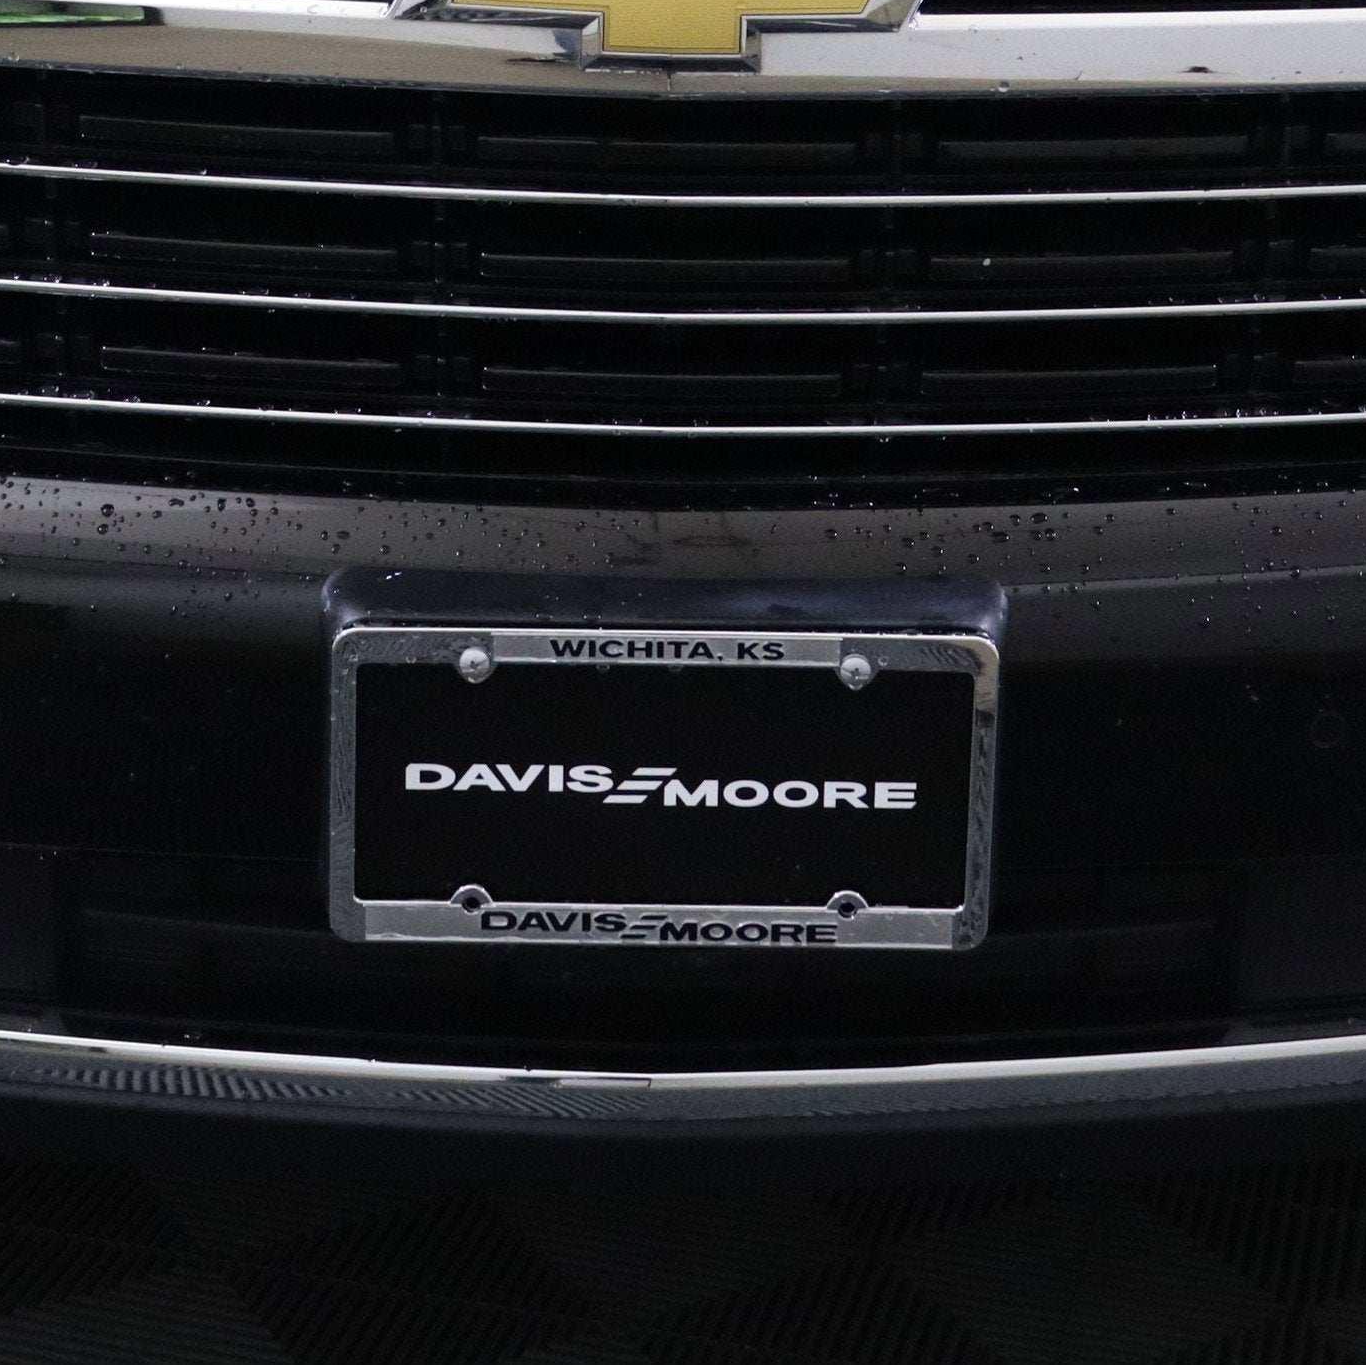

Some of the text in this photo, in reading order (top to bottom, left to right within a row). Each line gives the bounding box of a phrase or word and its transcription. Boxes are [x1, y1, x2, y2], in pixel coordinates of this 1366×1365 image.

[737, 642, 784, 661] KS
[405, 763, 917, 810] DAVIS MOORE
[481, 911, 837, 944] DAVIS MOORE
